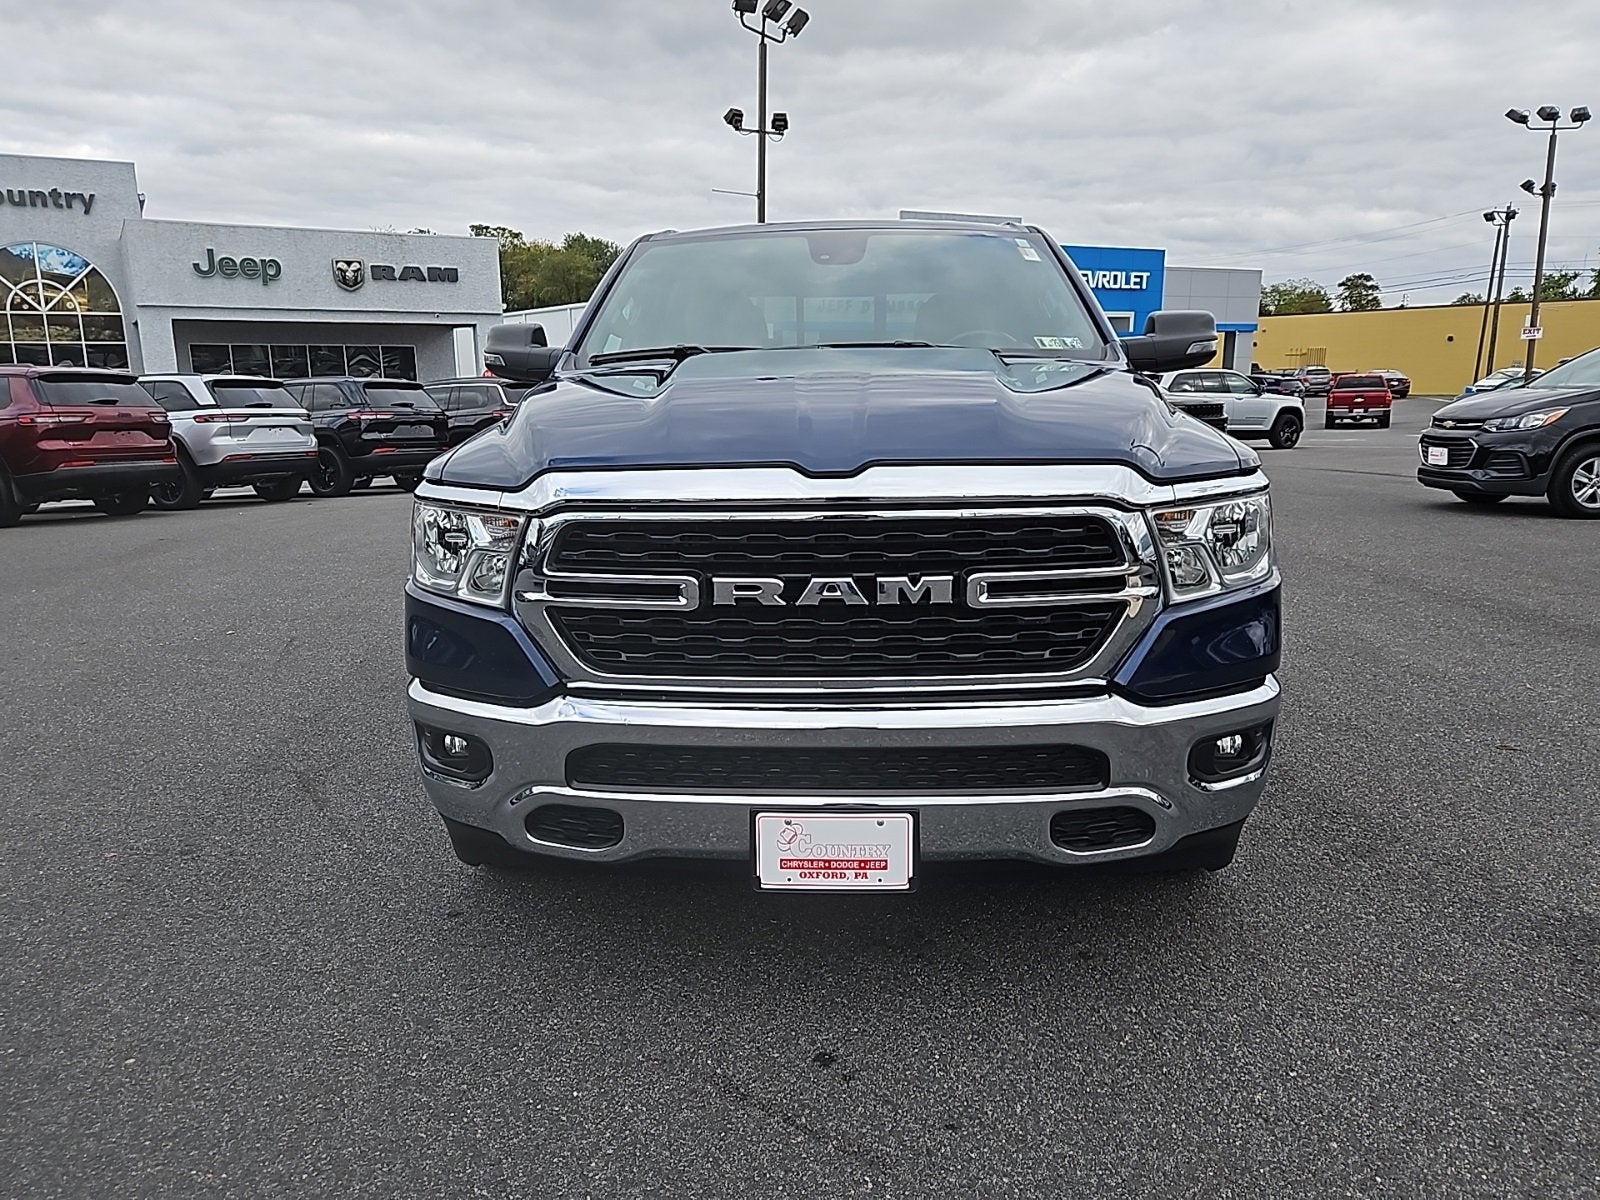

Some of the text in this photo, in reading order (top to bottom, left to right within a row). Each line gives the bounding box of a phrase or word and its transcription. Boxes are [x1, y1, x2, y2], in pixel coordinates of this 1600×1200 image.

[0, 187, 96, 215] untry
[192, 248, 282, 286] Jeep
[370, 264, 459, 283] RAM
[712, 576, 954, 606] RAM
[781, 860, 887, 869] CHRYSLER DODGE JEEP
[799, 871, 869, 880] OXFORD, PA
